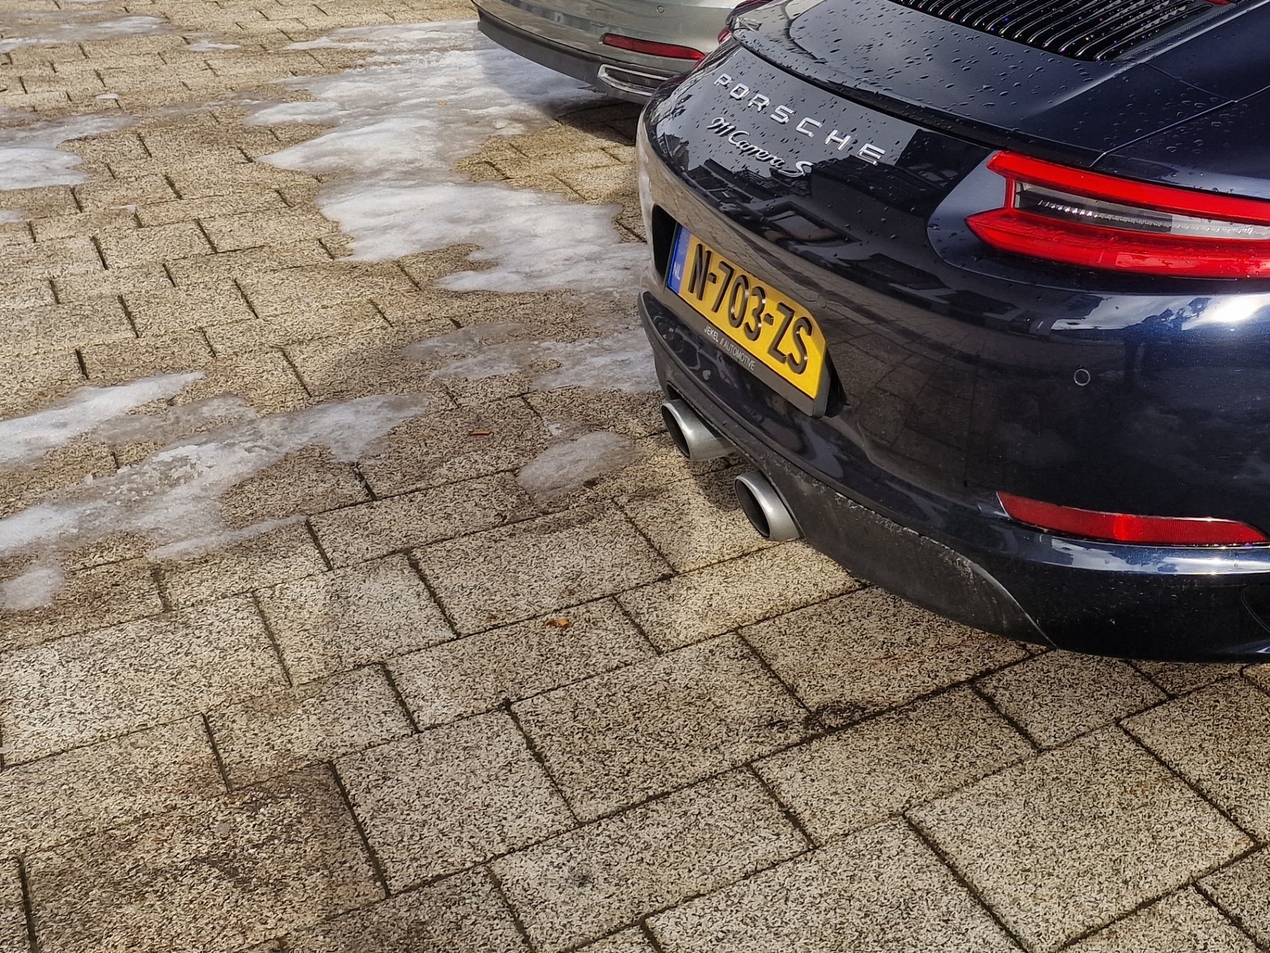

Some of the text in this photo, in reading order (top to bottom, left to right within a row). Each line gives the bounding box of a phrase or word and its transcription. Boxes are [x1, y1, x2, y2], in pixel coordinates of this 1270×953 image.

[713, 72, 886, 166] PORSCHE
[672, 262, 682, 281] NL
[687, 243, 813, 376] N-703-ZS
[723, 340, 756, 371] AUTOMOTIVE
